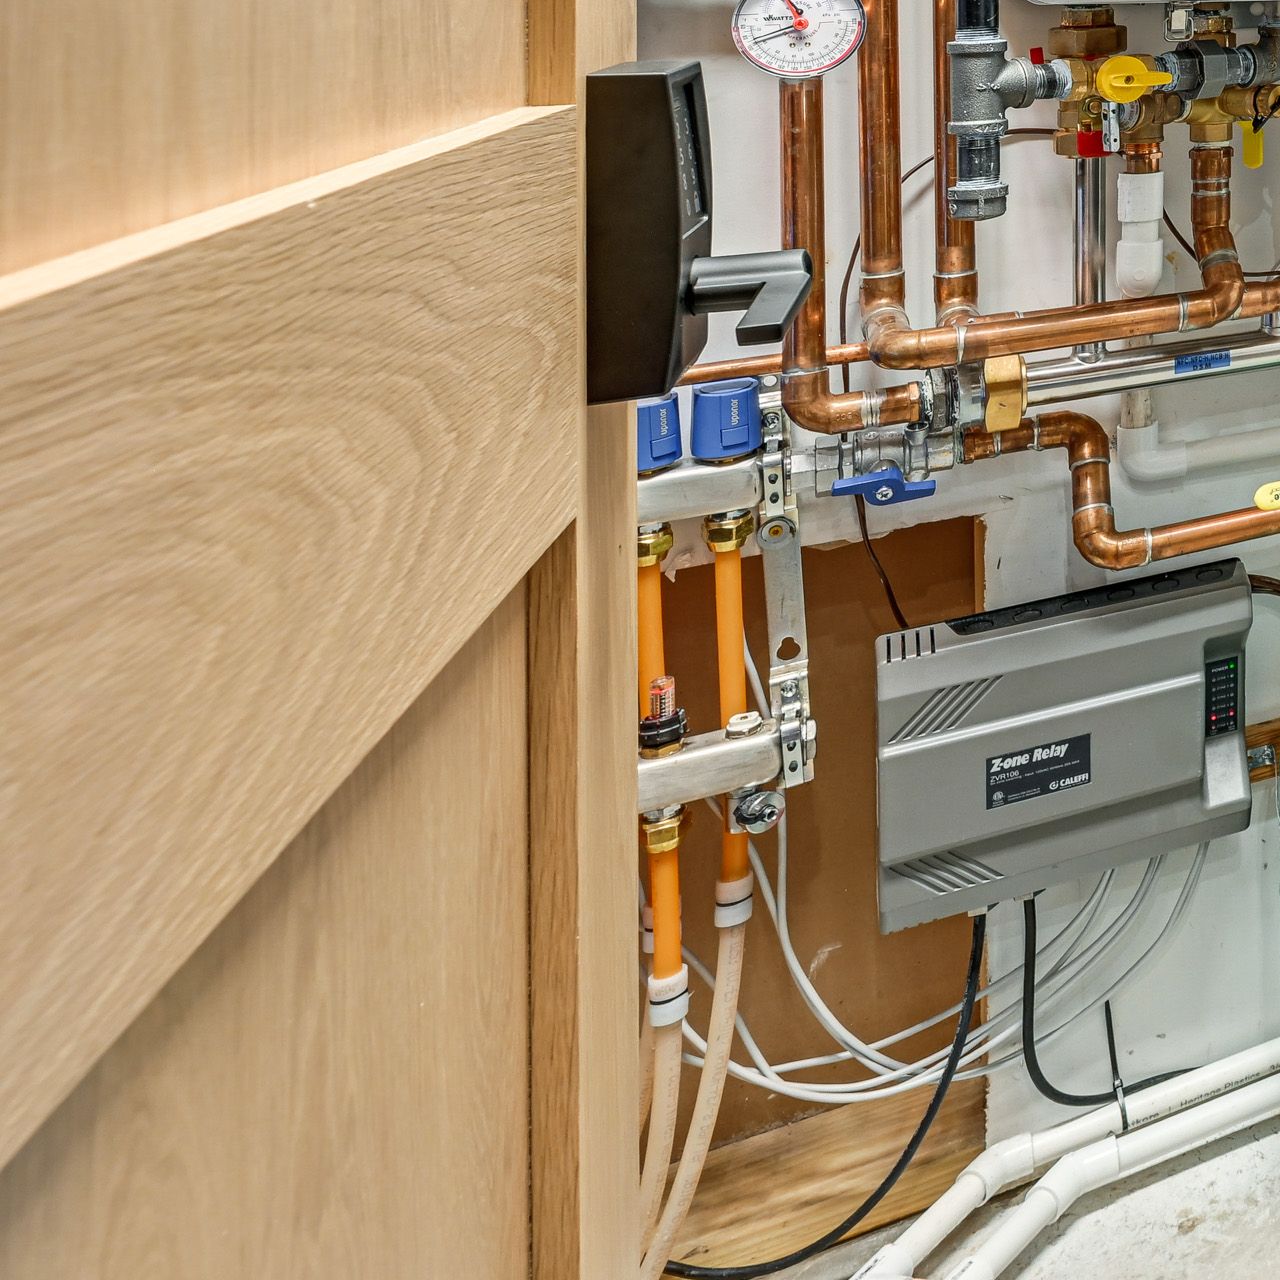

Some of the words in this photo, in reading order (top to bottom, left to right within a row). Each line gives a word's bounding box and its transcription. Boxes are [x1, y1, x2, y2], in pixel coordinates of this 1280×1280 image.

[660, 408, 668, 435] uponor
[731, 399, 739, 425] uponor
[1032, 743, 1069, 762] Relay
[990, 770, 1020, 783] ZVR106
[1060, 773, 1089, 787] CALEFFI
